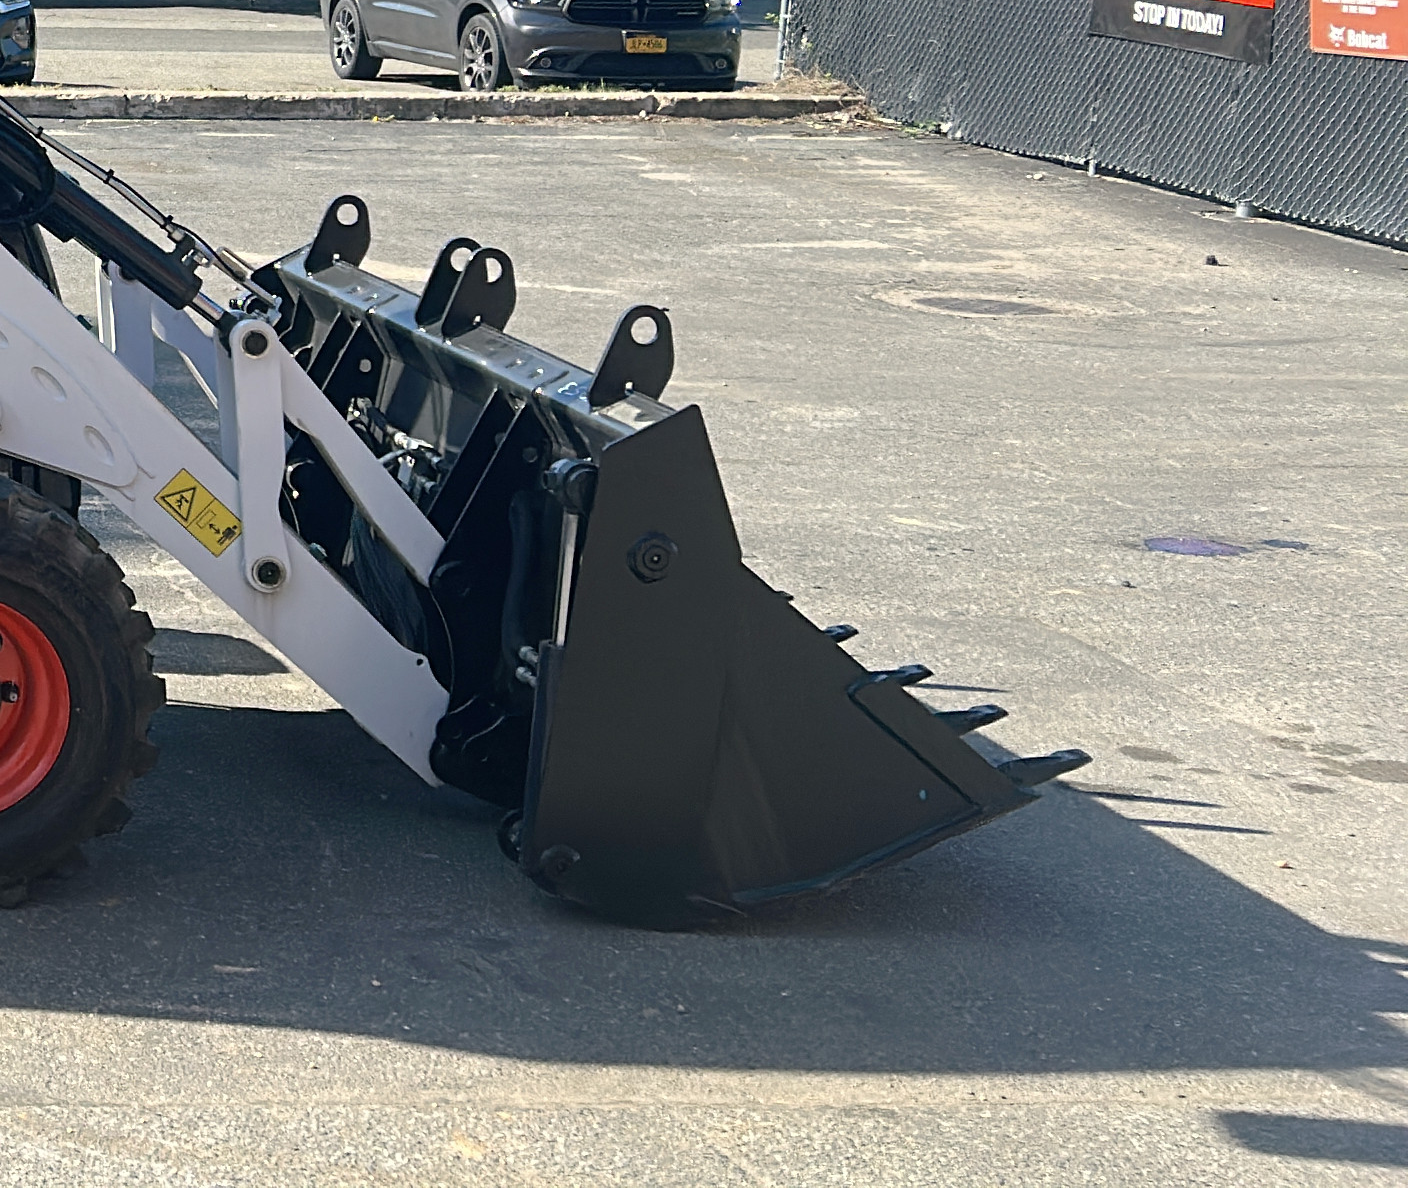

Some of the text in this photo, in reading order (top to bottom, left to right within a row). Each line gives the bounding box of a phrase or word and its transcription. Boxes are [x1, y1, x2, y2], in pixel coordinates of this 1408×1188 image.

[1133, 1, 1226, 37] STOP IN TODAY!
[1346, 29, 1388, 49] Bobcat
